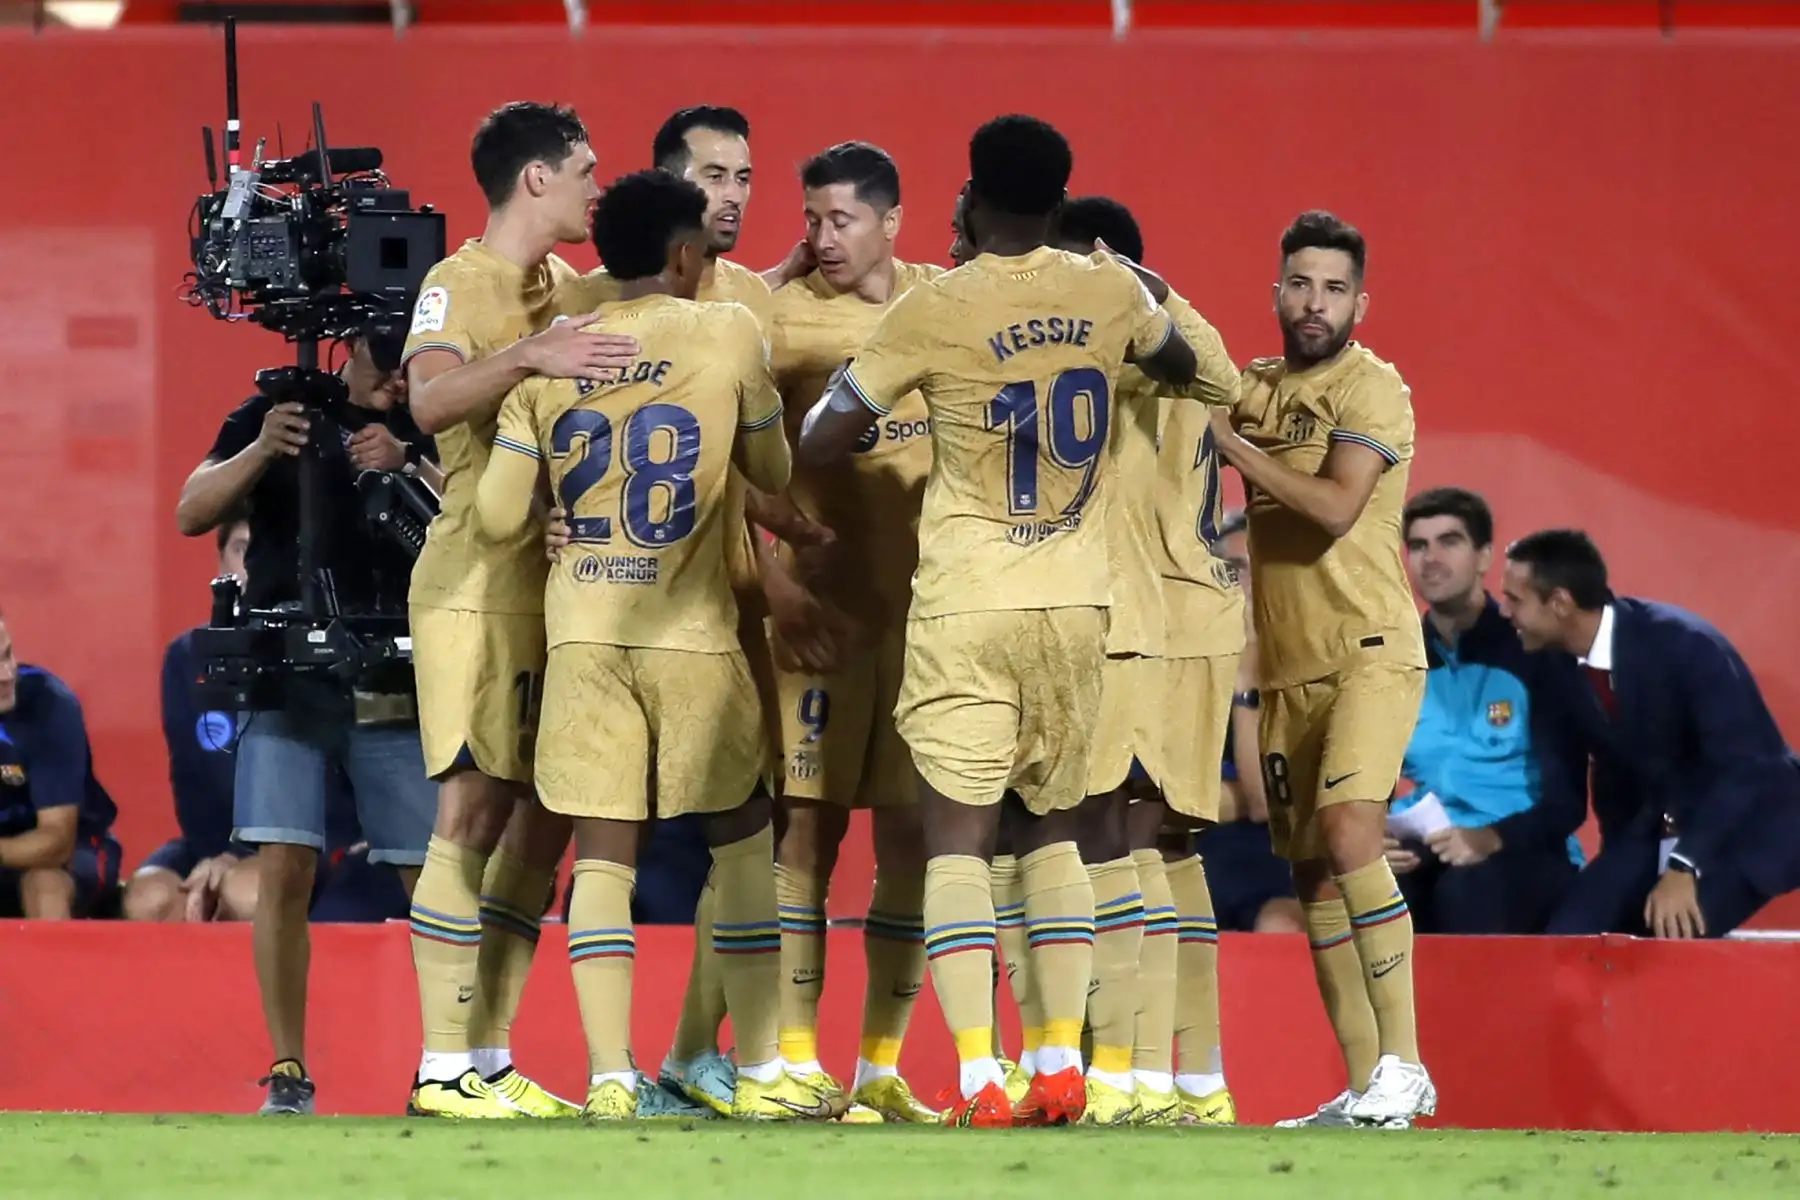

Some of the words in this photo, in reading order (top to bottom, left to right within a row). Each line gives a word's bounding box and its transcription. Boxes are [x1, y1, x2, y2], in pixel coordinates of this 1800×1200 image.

[987, 316, 1093, 363] KESSIE
[574, 360, 673, 396] BLDE
[984, 366, 1110, 516] 19
[549, 403, 701, 549] 28
[605, 556, 658, 569] UNHCR
[606, 568, 657, 580] ACNUR
[797, 688, 830, 745] 9
